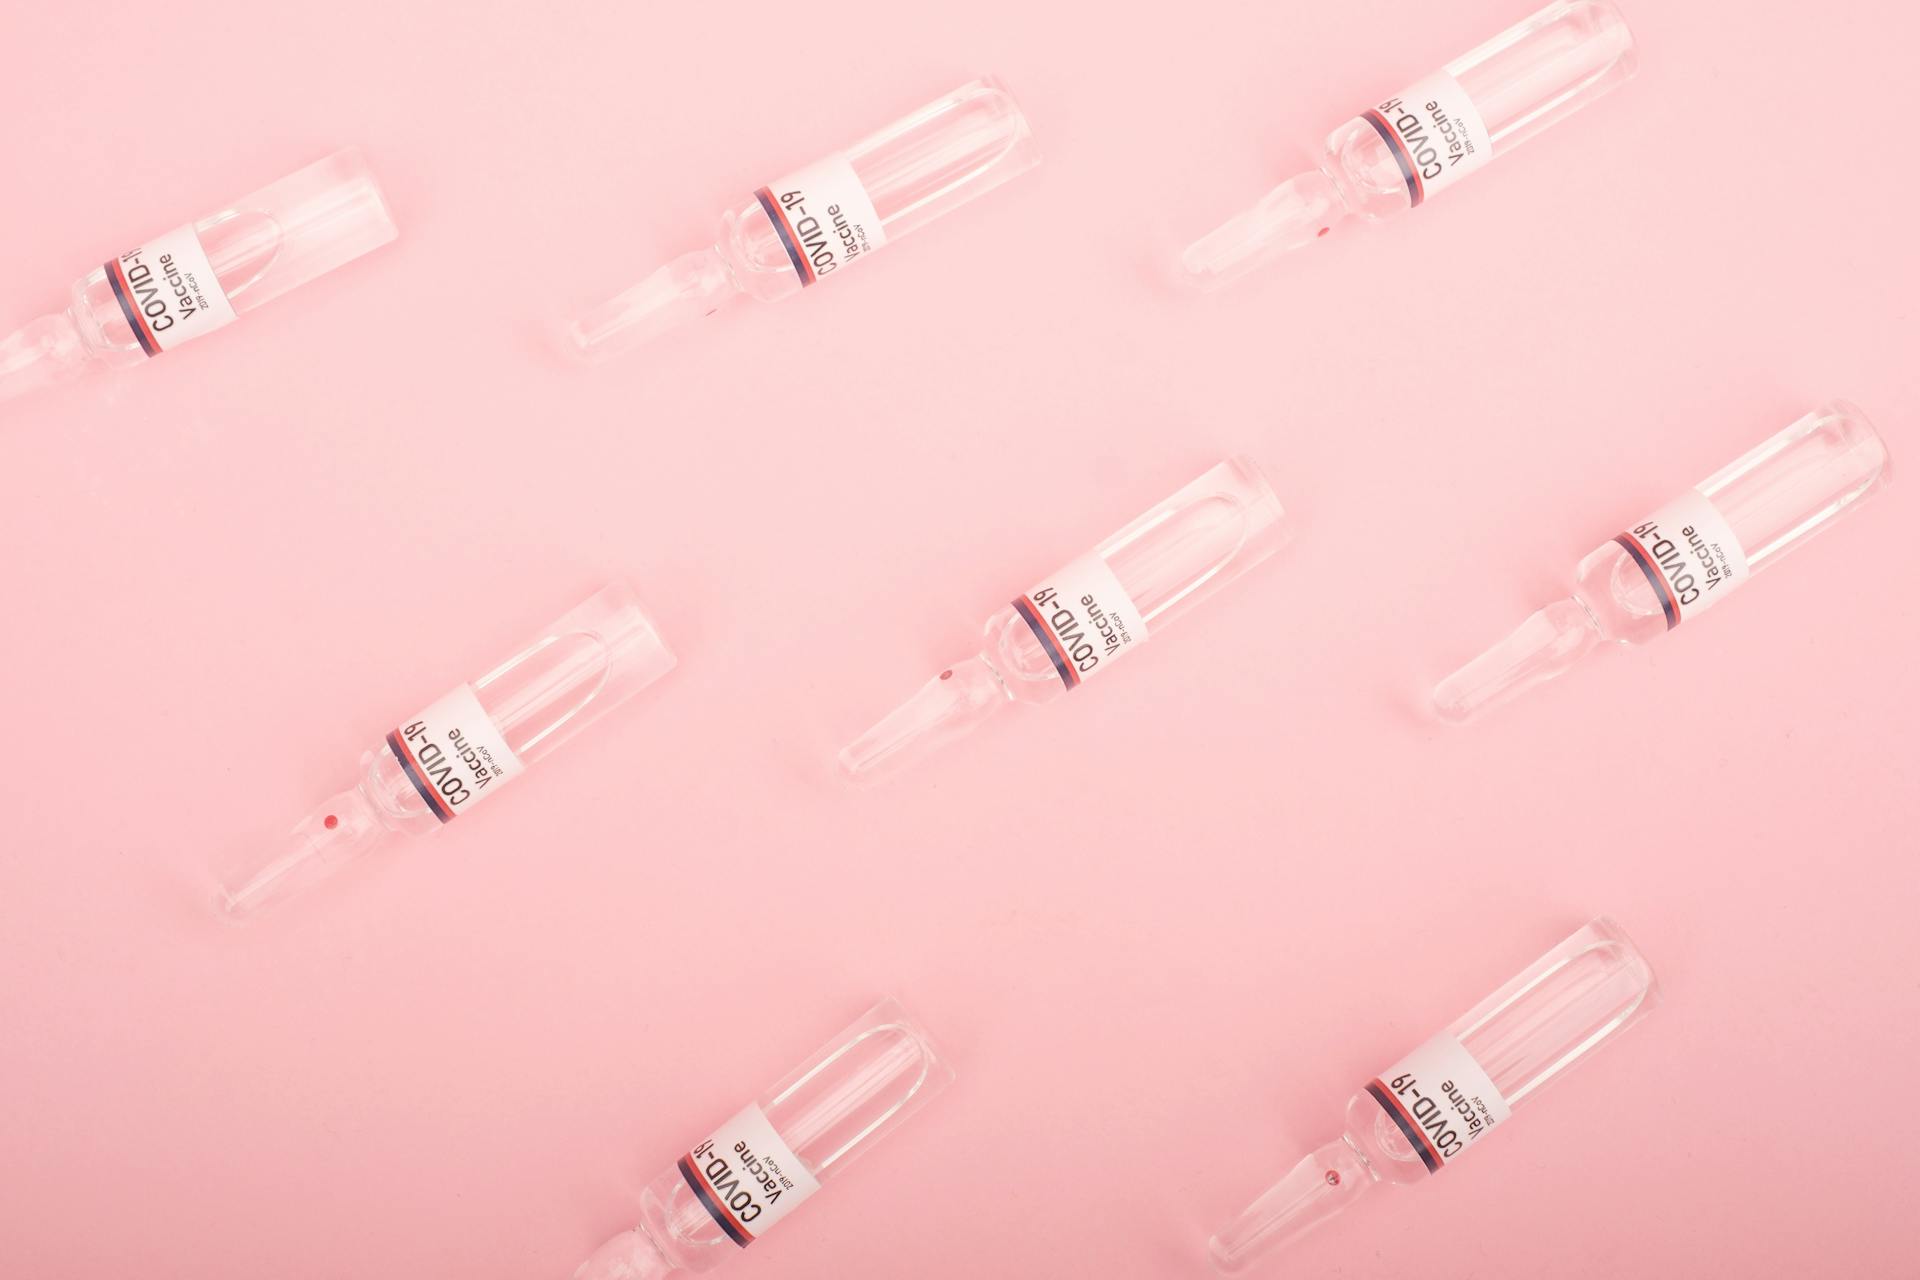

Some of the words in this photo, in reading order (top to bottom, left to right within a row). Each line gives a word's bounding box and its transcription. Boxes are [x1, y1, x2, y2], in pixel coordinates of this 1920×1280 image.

[1379, 98, 1442, 180] COVID-19
[1426, 101, 1464, 166] Vaccine
[781, 191, 837, 276] COVID-19
[828, 204, 860, 262] Vaccine
[160, 254, 196, 319] Vaccine
[184, 273, 208, 310] 2019-nCoV
[1633, 522, 1700, 605] COVID-19
[1682, 525, 1721, 590] Vaccine
[1033, 588, 1099, 672] COVID-19
[1081, 594, 1120, 656] Vaccine
[404, 721, 470, 806] COVID-19
[448, 728, 492, 789] Vaccine
[1391, 1074, 1462, 1158] COVID-19
[1441, 1080, 1484, 1140] Vaccine
[694, 1139, 761, 1222] COVID-19
[734, 1141, 782, 1204] Vaccine
[763, 1156, 794, 1190] 2019-nCoV
